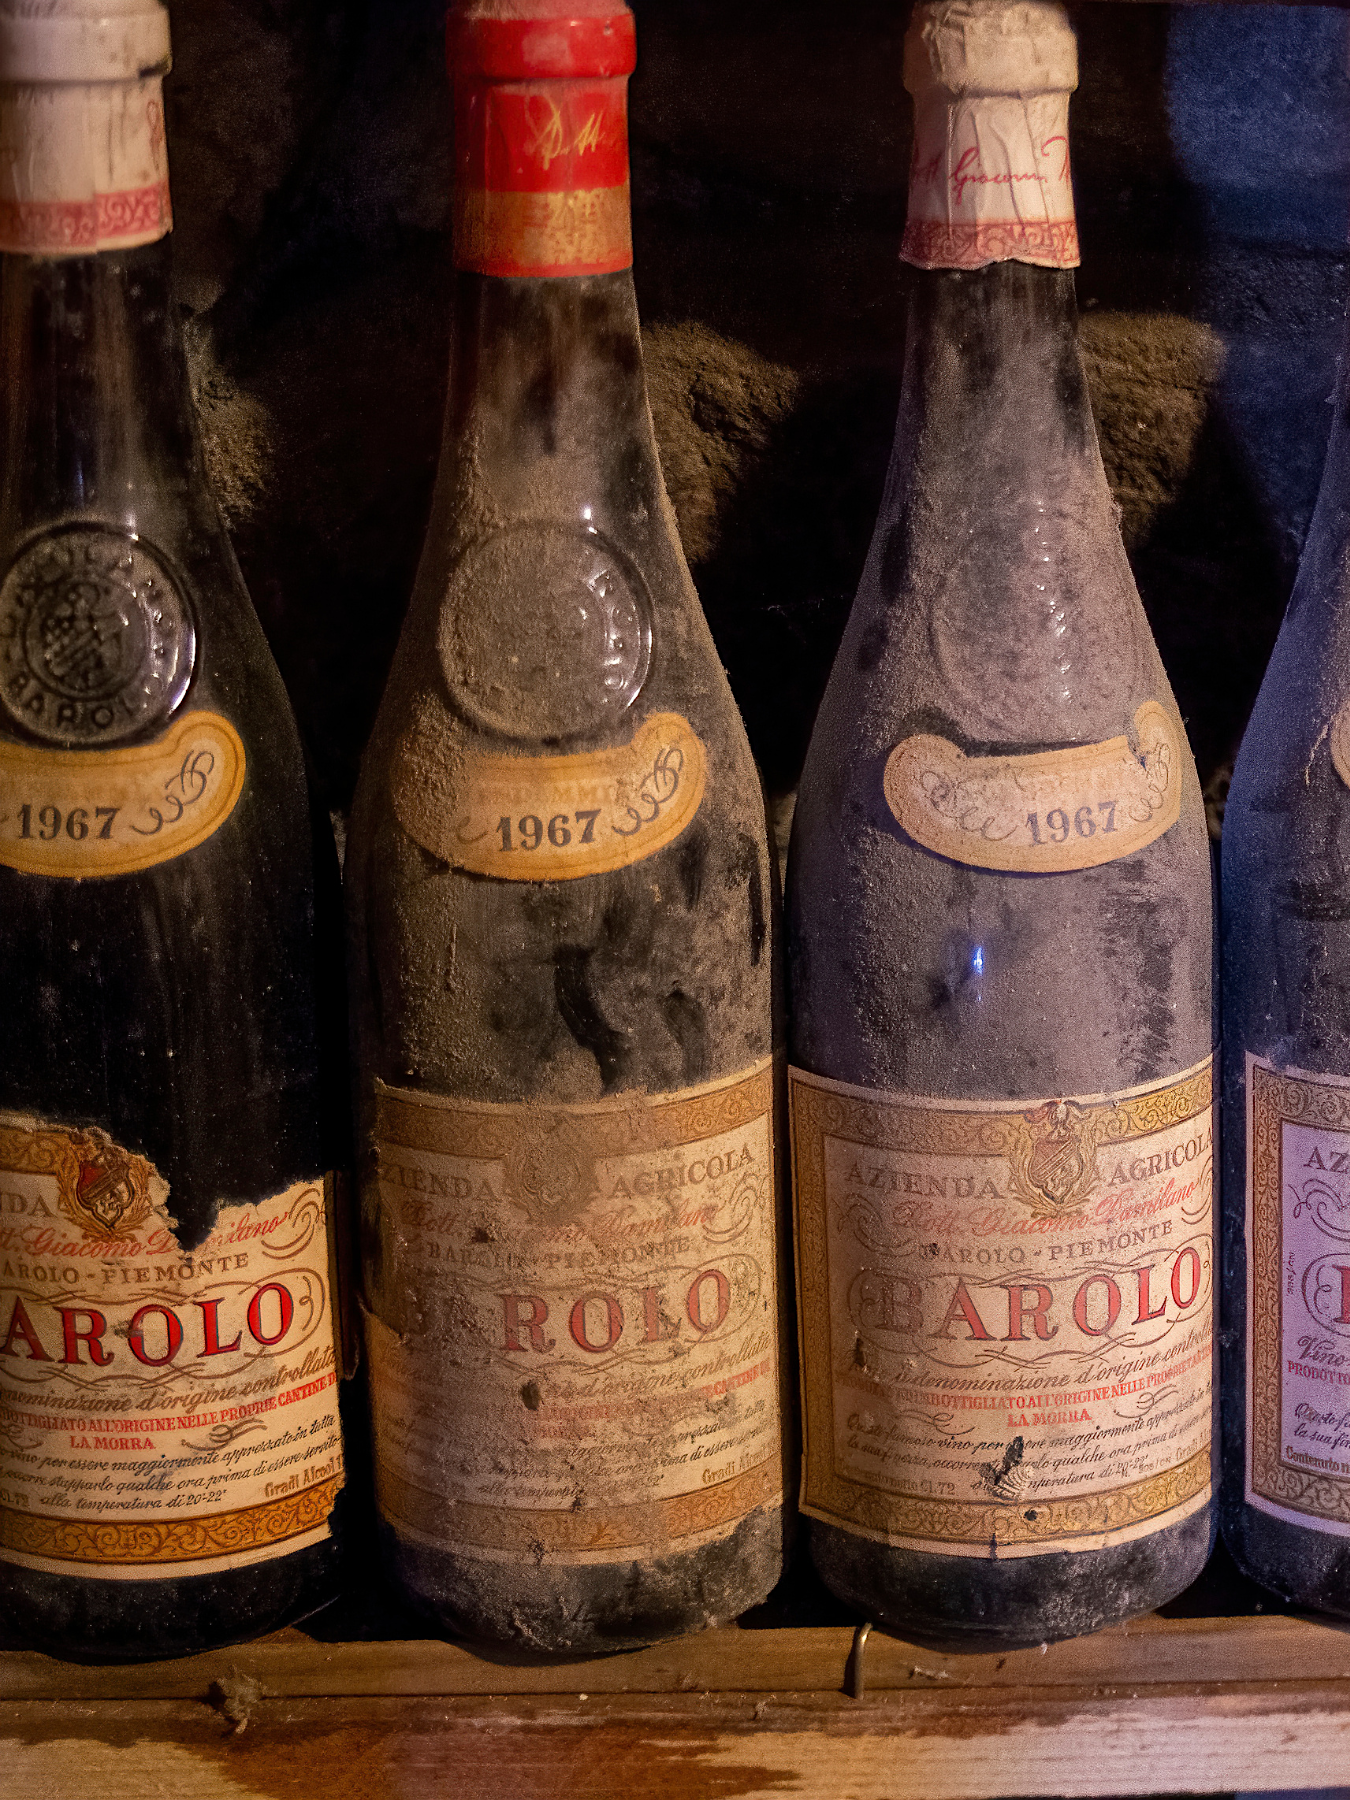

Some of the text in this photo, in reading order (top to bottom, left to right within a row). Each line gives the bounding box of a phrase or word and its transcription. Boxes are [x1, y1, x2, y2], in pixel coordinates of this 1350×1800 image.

[16, 803, 121, 841] 1967
[495, 808, 604, 853] 1967
[1025, 799, 1120, 847] 1967
[607, 1142, 756, 1199] AGRICOLA
[844, 1126, 1212, 1200] AZIENDA AGRICOLA
[966, 1176, 1200, 1238] Giacomo Damilano
[22, 1224, 147, 1259] Giacomo
[1048, 1219, 1173, 1261] PIEMONTE
[100, 1251, 249, 1285] PIEMONTE
[866, 1247, 1202, 1343] BAROLO
[0, 1281, 295, 1367] AROLO
[1297, 1335, 1348, 1368] Vino
[911, 1370, 1070, 1392] denominazione
[1075, 1351, 1162, 1384] d'origine
[88, 1376, 327, 1433] ALL'ORIGINE NELLE PROPRIE CANTINE
[136, 1381, 237, 1415] d'origine
[1026, 1379, 1145, 1408] ALL'ORIGINE NELLE
[938, 1416, 1144, 1455] vino per maggiormente
[1008, 1408, 1093, 1428] LA MORRA
[1294, 1424, 1307, 1438] la
[1308, 1433, 1332, 1444] sua
[37, 1413, 336, 1477] per essere maggiormente apprezzato in tutta
[70, 1435, 157, 1451] LA MORRA
[1050, 1445, 1107, 1471] qualche
[1108, 1446, 1132, 1460] ora
[1131, 1433, 1168, 1458] prima
[1286, 1445, 1340, 1472] Contenuto
[40, 1456, 335, 1514] alla temperatura di Gradi Alcool
[50, 1455, 302, 1495] stapparlo qualche ora prima di essere
[702, 1458, 736, 1485] Gradi
